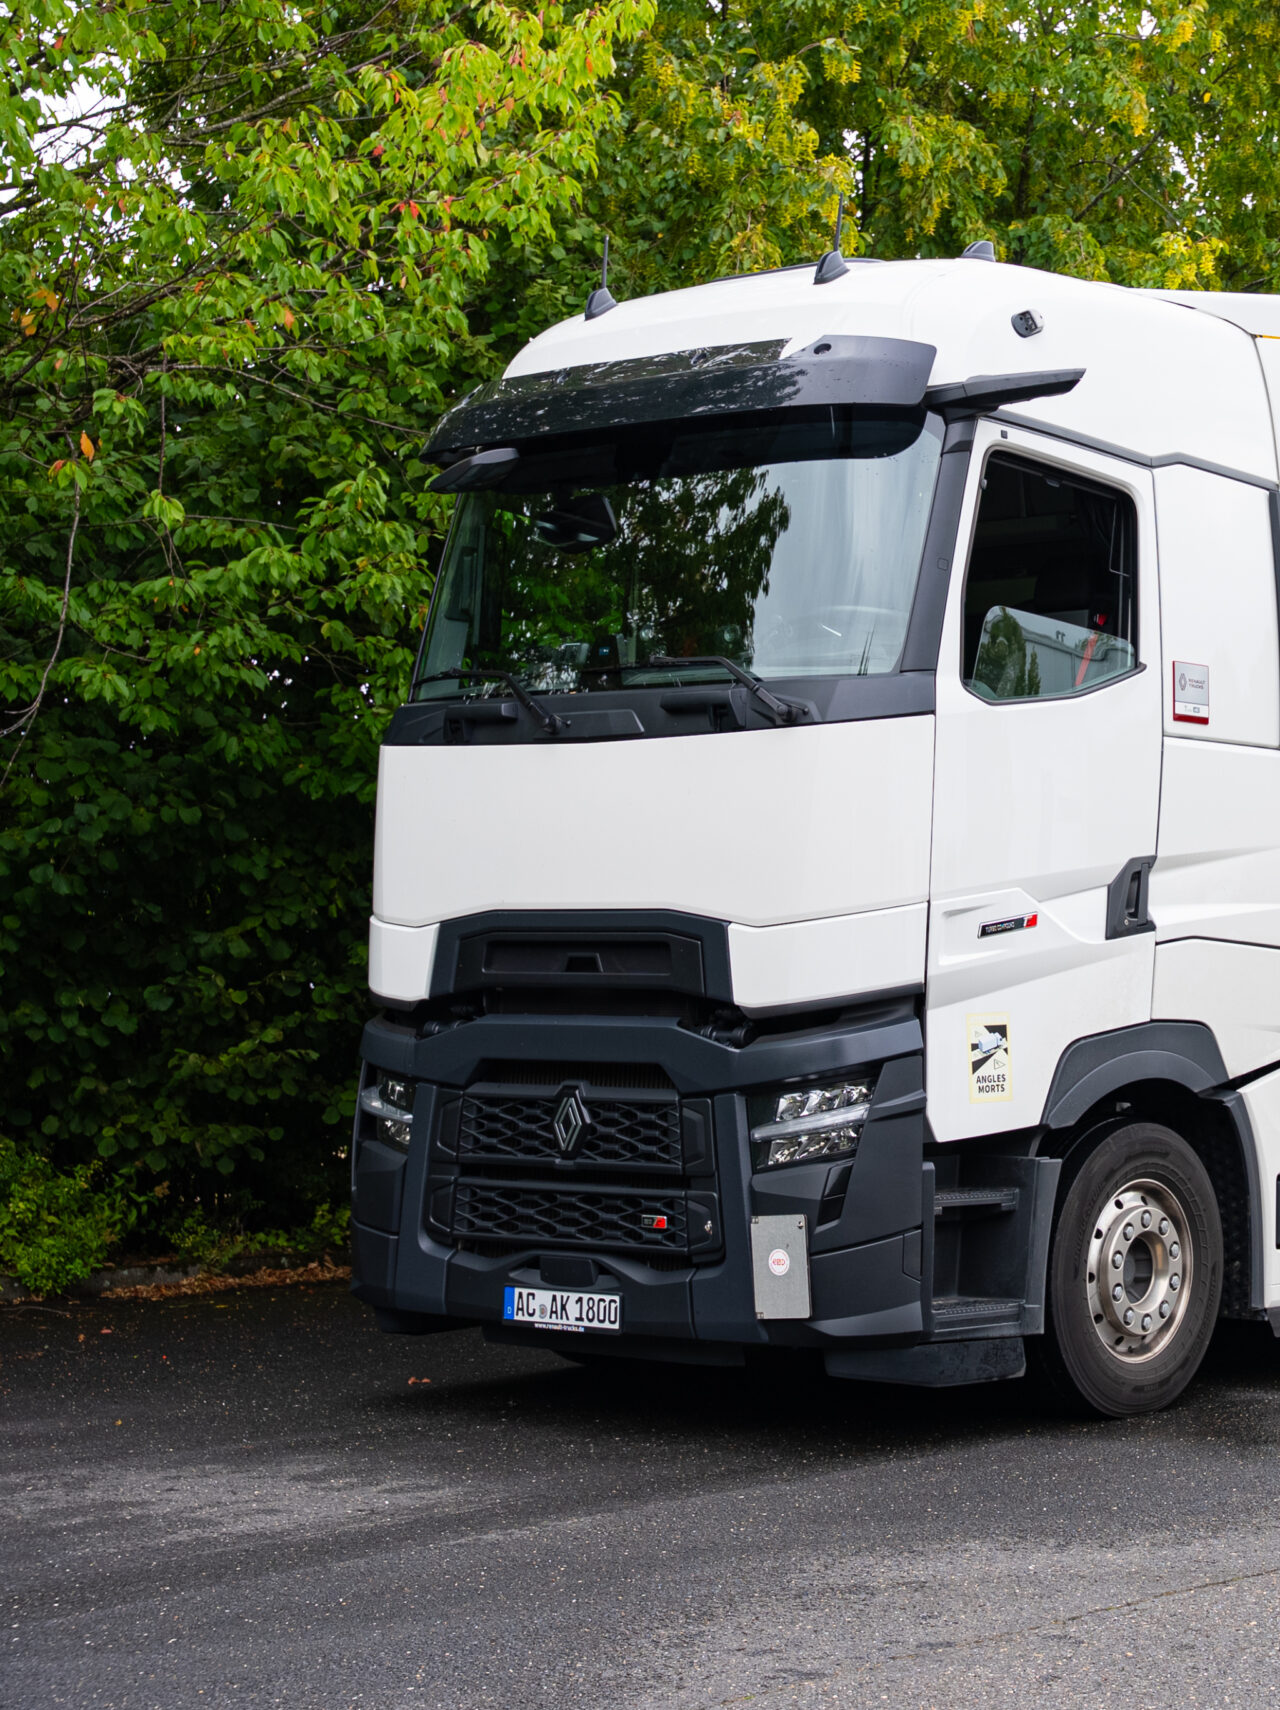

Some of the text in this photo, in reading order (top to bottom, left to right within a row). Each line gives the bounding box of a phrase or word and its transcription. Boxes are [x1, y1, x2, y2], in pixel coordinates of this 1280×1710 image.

[976, 1074, 1006, 1084] ANGLES
[978, 1084, 1006, 1094] MORTS
[516, 1291, 617, 1324] AC AK 1800
